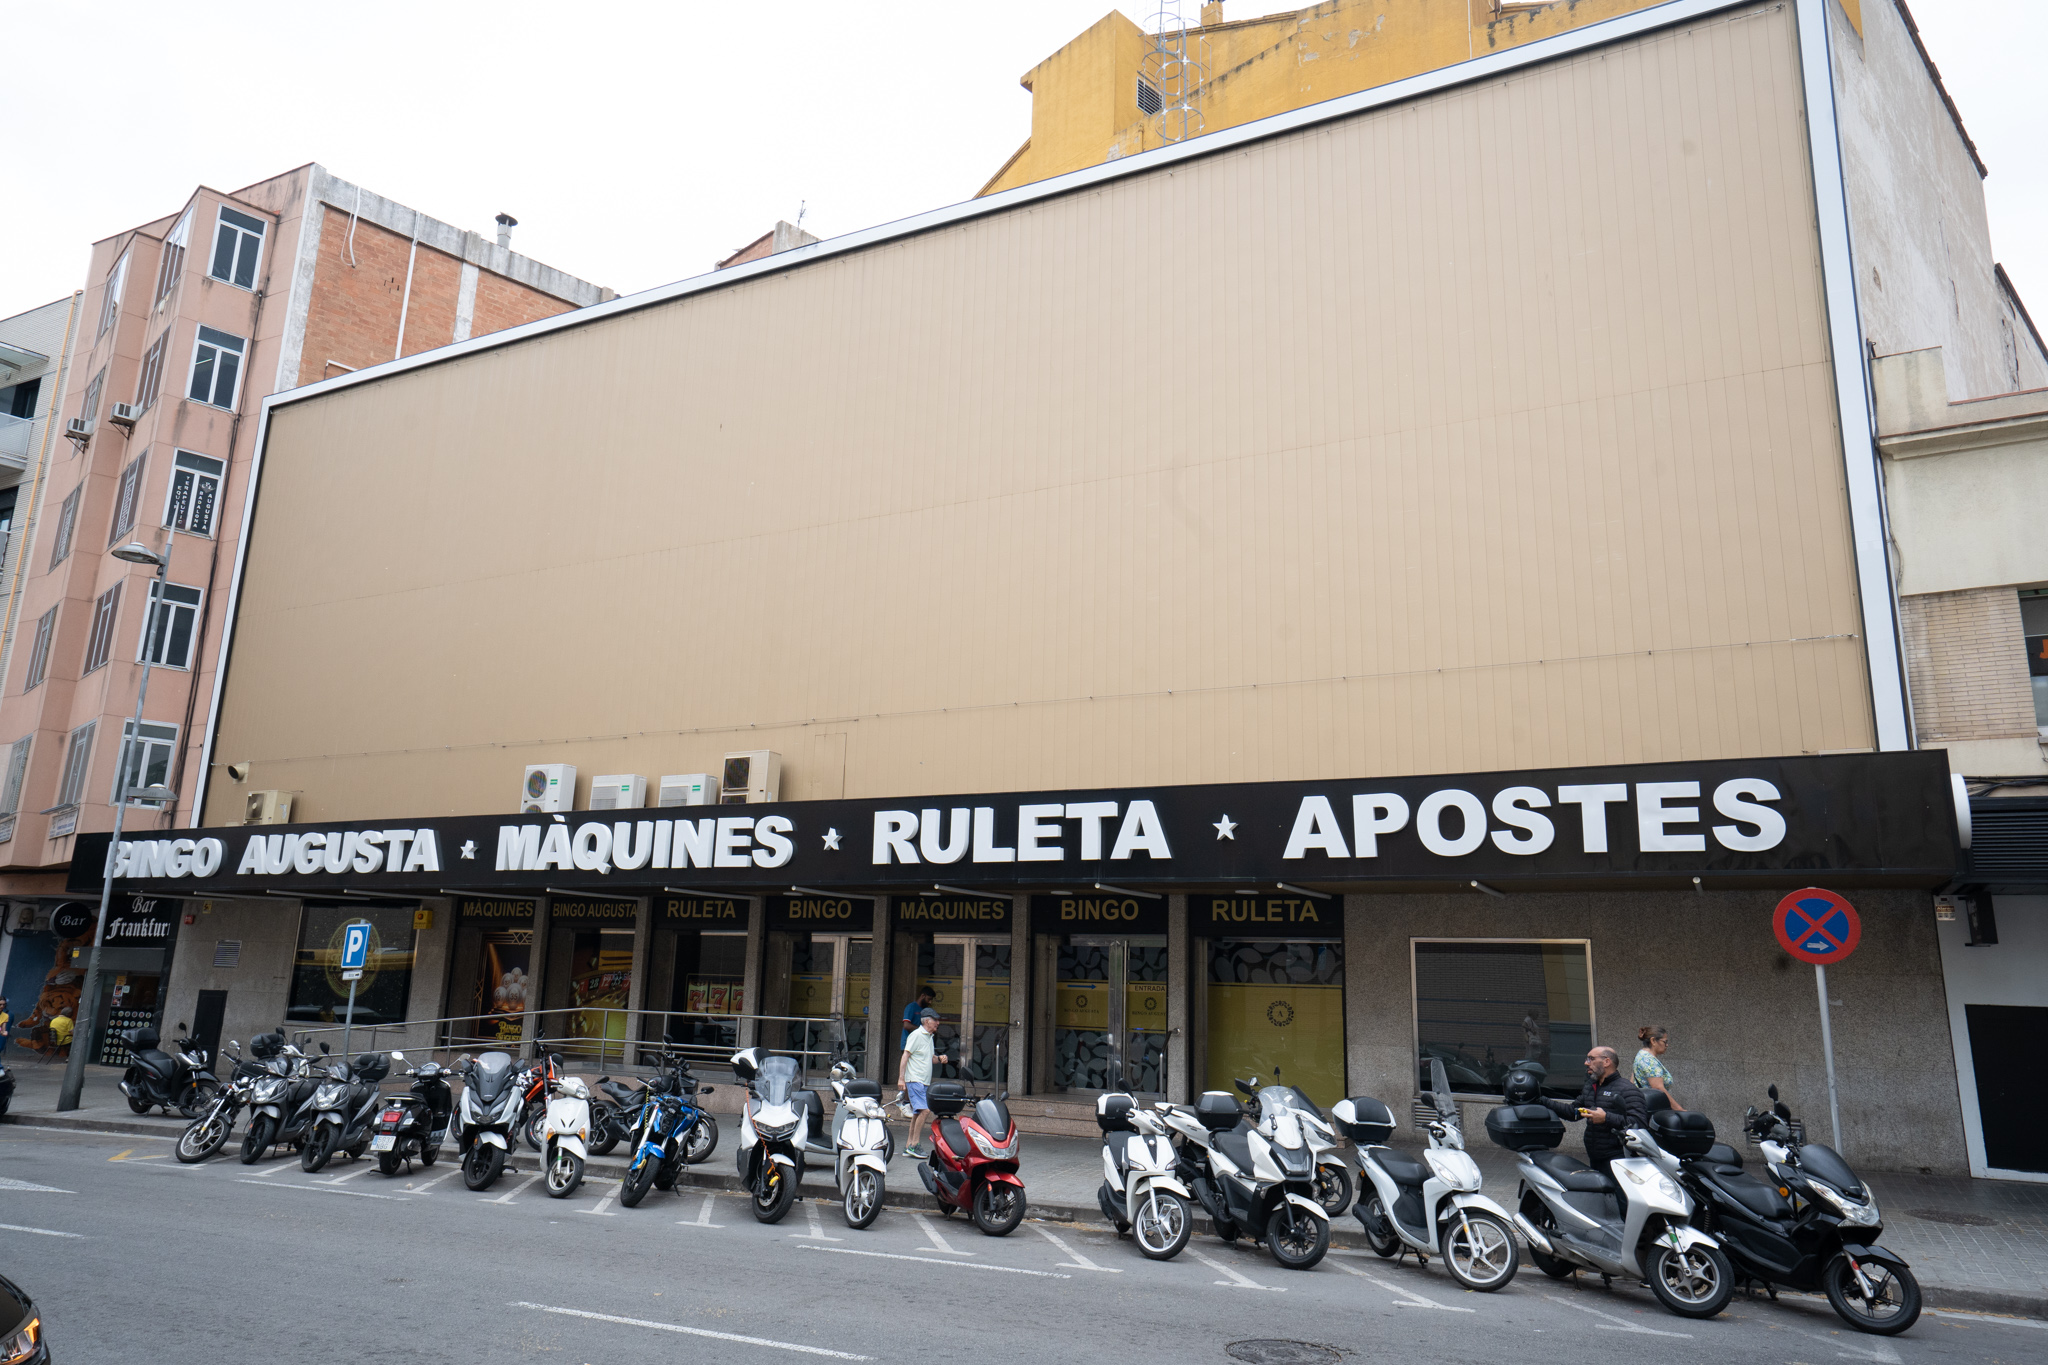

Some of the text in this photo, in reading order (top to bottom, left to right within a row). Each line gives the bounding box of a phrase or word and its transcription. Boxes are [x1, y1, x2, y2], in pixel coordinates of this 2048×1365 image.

[193, 491, 204, 528] BADALONA
[202, 493, 213, 530] AUGUSTA
[104, 778, 1787, 878] BINGO AUGUSTA MÀQUINES RULETA APOSTES
[132, 896, 158, 914] Bar
[462, 899, 534, 917] MÀQUINES
[553, 903, 638, 918] BINGO AUGUSTA
[667, 900, 736, 917] RULETA
[789, 901, 852, 918] BINGO
[900, 898, 1004, 920] MÀQUINES
[1061, 900, 1139, 920] BINGO
[1212, 900, 1318, 921] RULETA
[60, 915, 86, 927] Bar
[105, 917, 171, 940] Frankfur
[346, 930, 363, 963] P
